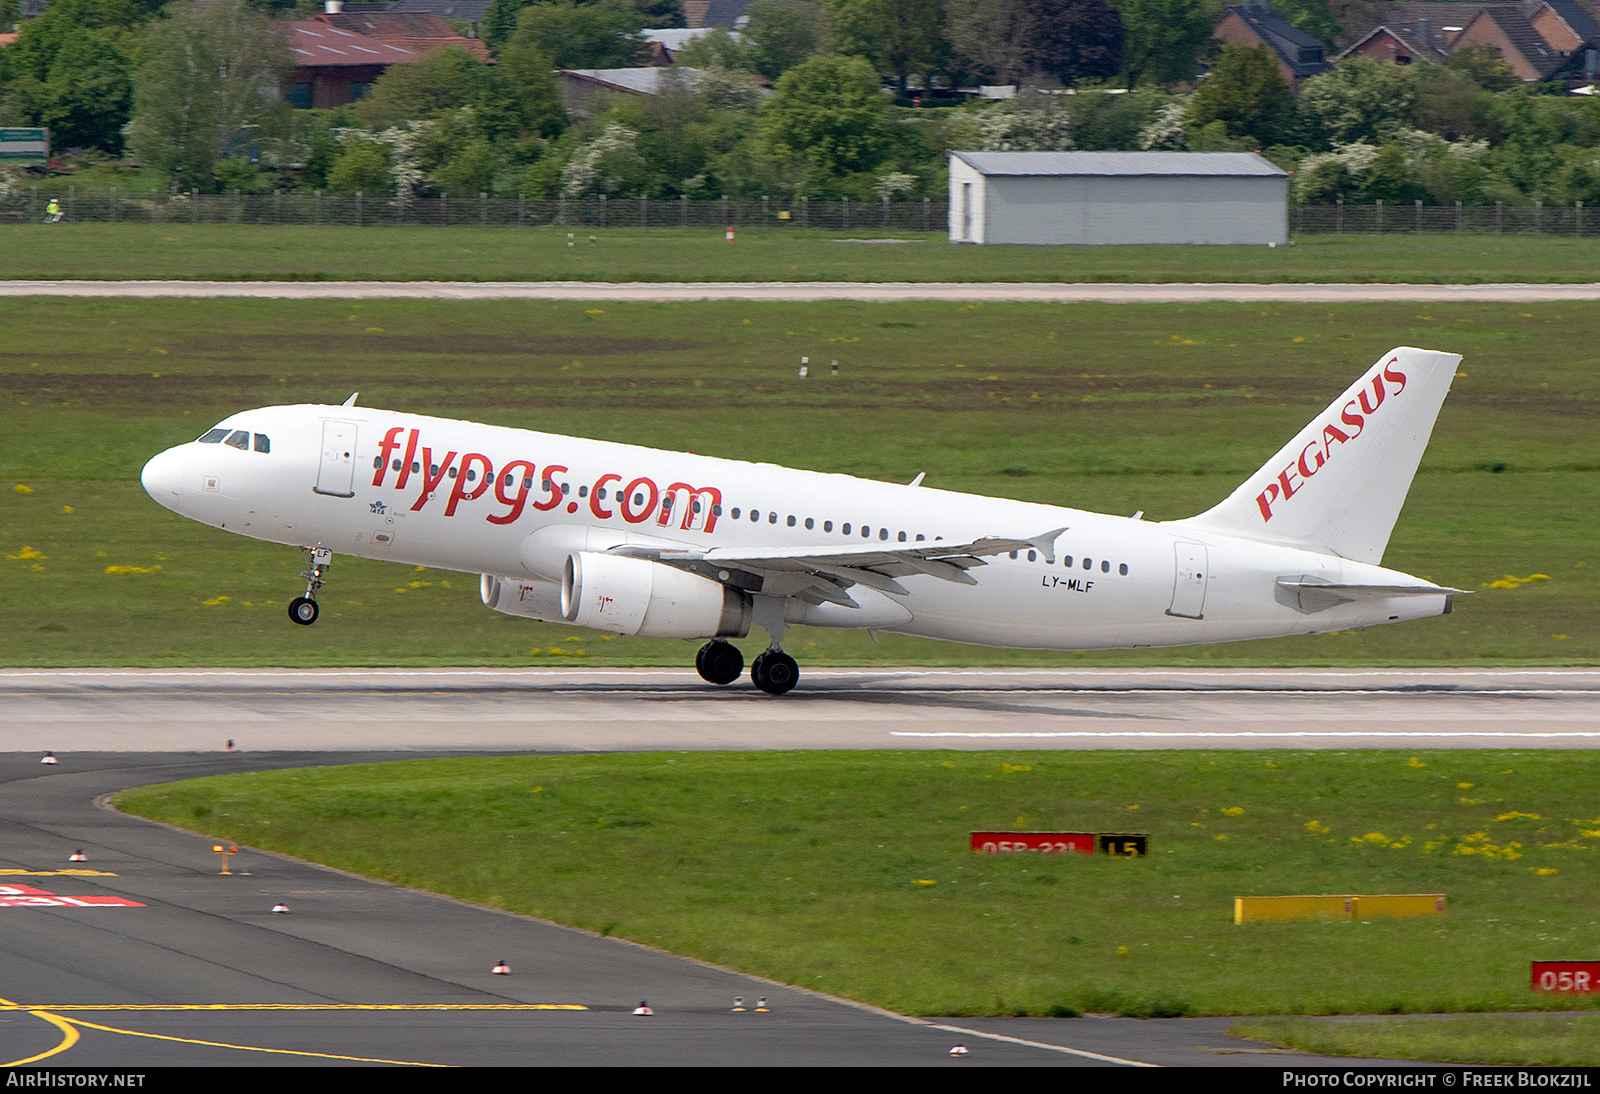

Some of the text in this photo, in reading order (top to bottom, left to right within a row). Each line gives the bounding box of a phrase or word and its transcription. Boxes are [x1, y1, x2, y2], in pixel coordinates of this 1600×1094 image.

[1256, 357, 1407, 523] PEGASUS
[371, 426, 722, 534] flypgs.com
[317, 550, 329, 558] LF
[1042, 575, 1094, 593] LY-MLF
